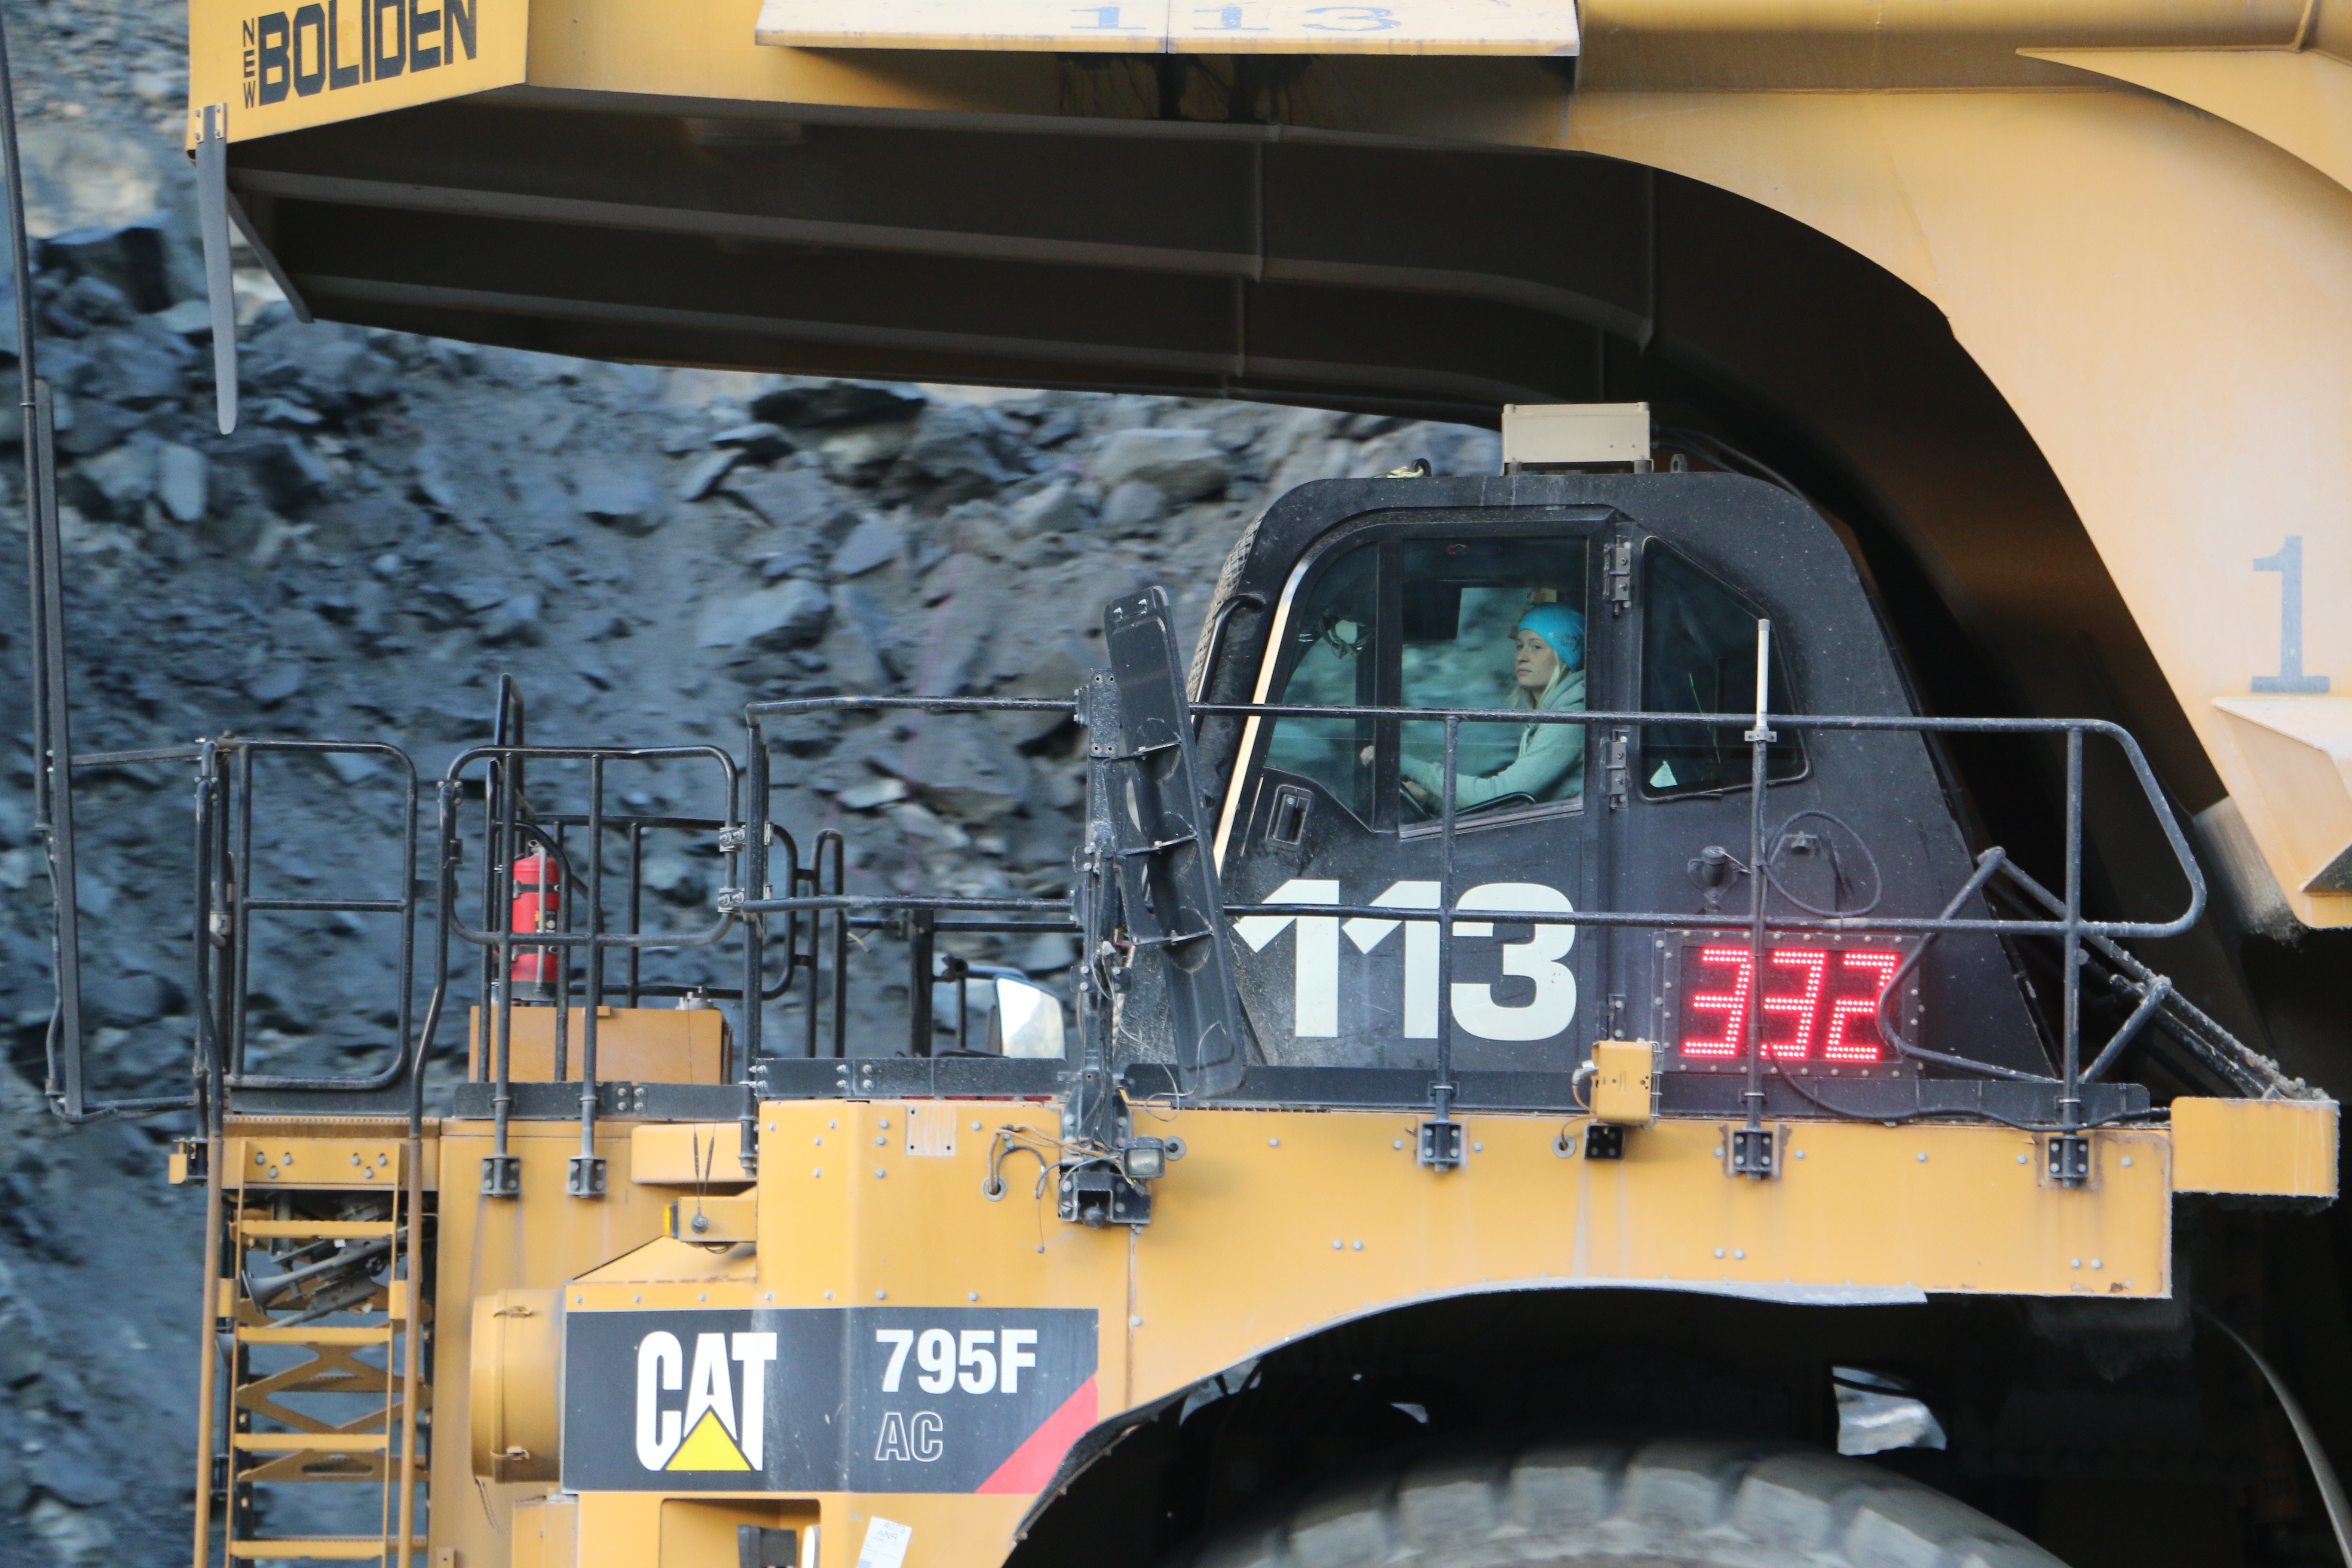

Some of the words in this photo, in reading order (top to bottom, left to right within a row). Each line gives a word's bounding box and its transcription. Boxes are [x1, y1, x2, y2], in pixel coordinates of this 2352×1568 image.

[242, 18, 256, 109] NEW
[258, 0, 477, 106] BOLIDEN
[1070, 6, 1403, 31] 113
[2250, 536, 2330, 693] 1
[1233, 879, 1577, 1041] 113
[1684, 948, 1896, 1060] 332
[636, 1331, 777, 1471] CAT
[876, 1329, 1038, 1394] 795F
[874, 1411, 944, 1462] AC
